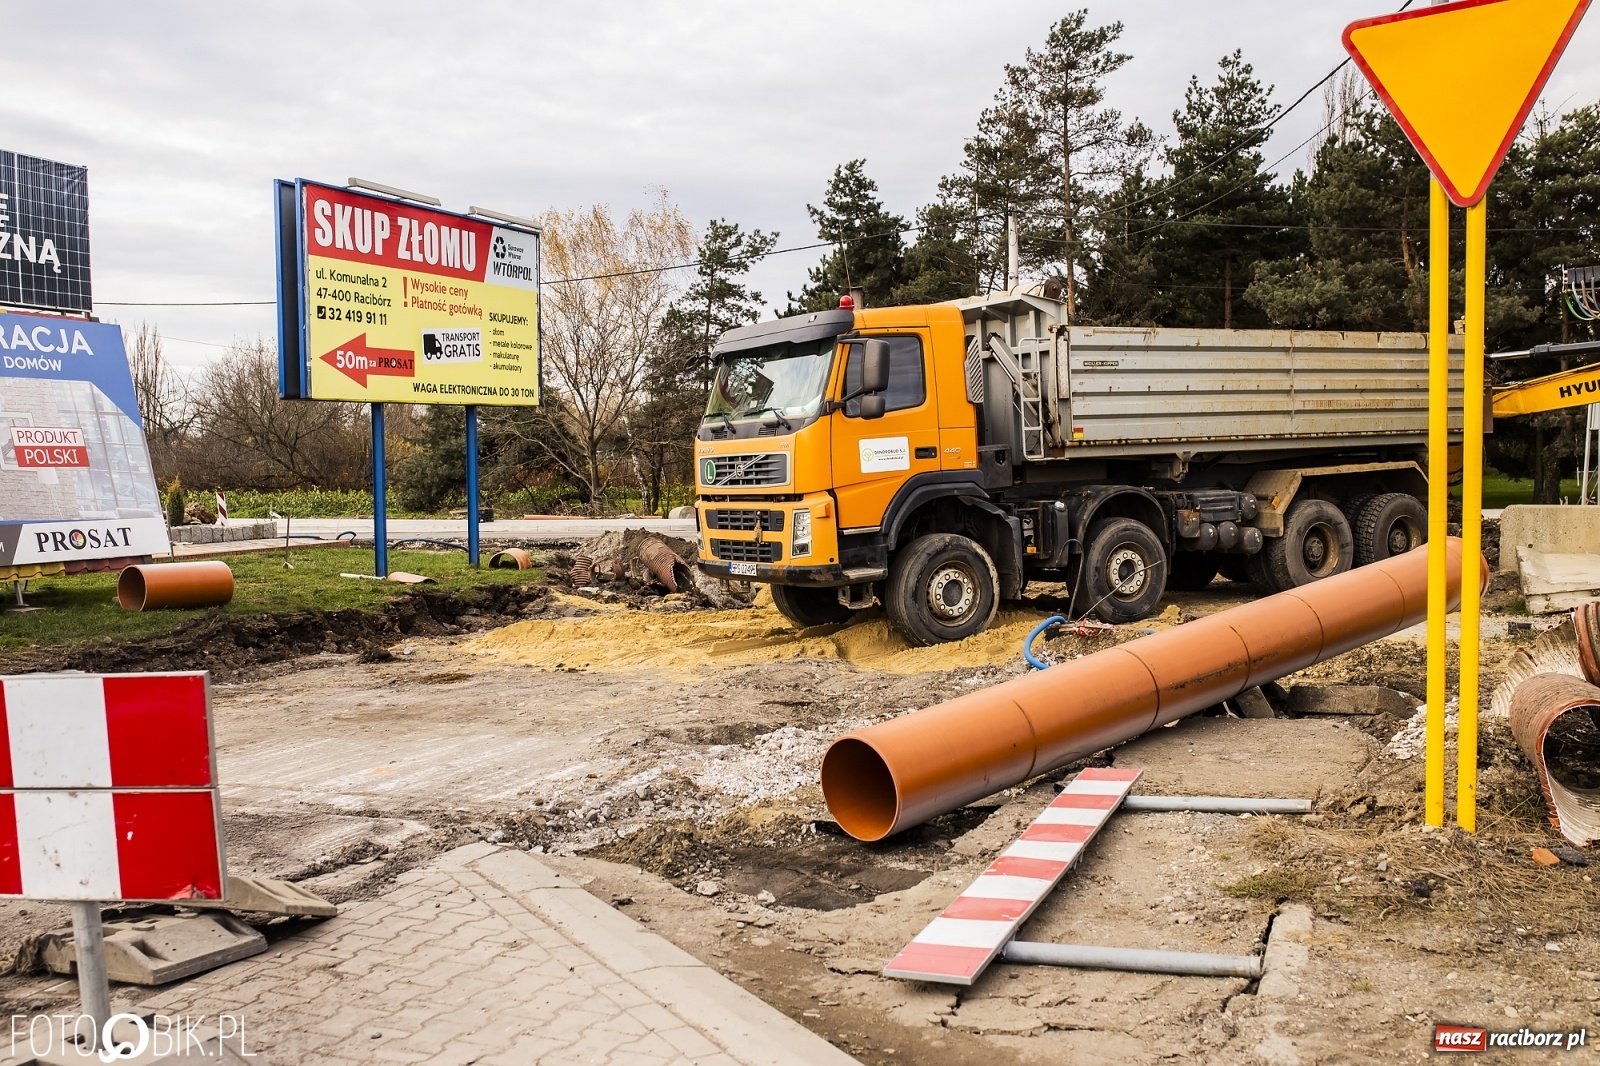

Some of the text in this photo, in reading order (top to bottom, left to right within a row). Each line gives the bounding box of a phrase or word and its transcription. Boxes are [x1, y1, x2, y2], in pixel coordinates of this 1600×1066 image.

[313, 199, 477, 272] SKUP ZŁOMU
[315, 268, 387, 288] ul. Komunalna 2
[493, 261, 532, 281] WTÓRPOL
[316, 287, 391, 307] 47-400 Racibórz
[410, 278, 469, 300] Wysokie ceny
[328, 307, 387, 326] 32 419 91 11
[411, 296, 483, 320] Płatność gotówką
[489, 312, 529, 326] SKUPUJEMY:
[441, 332, 480, 342] TRANSPORT
[492, 340, 532, 350] metale kolorowe
[444, 343, 481, 358] GRATIS
[492, 351, 520, 362] makulaturę
[3, 355, 62, 372] DOMÓW
[335, 350, 368, 369] 50m
[378, 356, 415, 370] PROSAT
[492, 362, 523, 374] akumulatory
[413, 382, 535, 398] WAGA ELEKTRONICZNA DO 30 TON
[1559, 379, 1600, 398] HYU
[16, 430, 78, 444] PRODUKT
[24, 448, 80, 465] POLSKI
[34, 527, 132, 553] PROSAT
